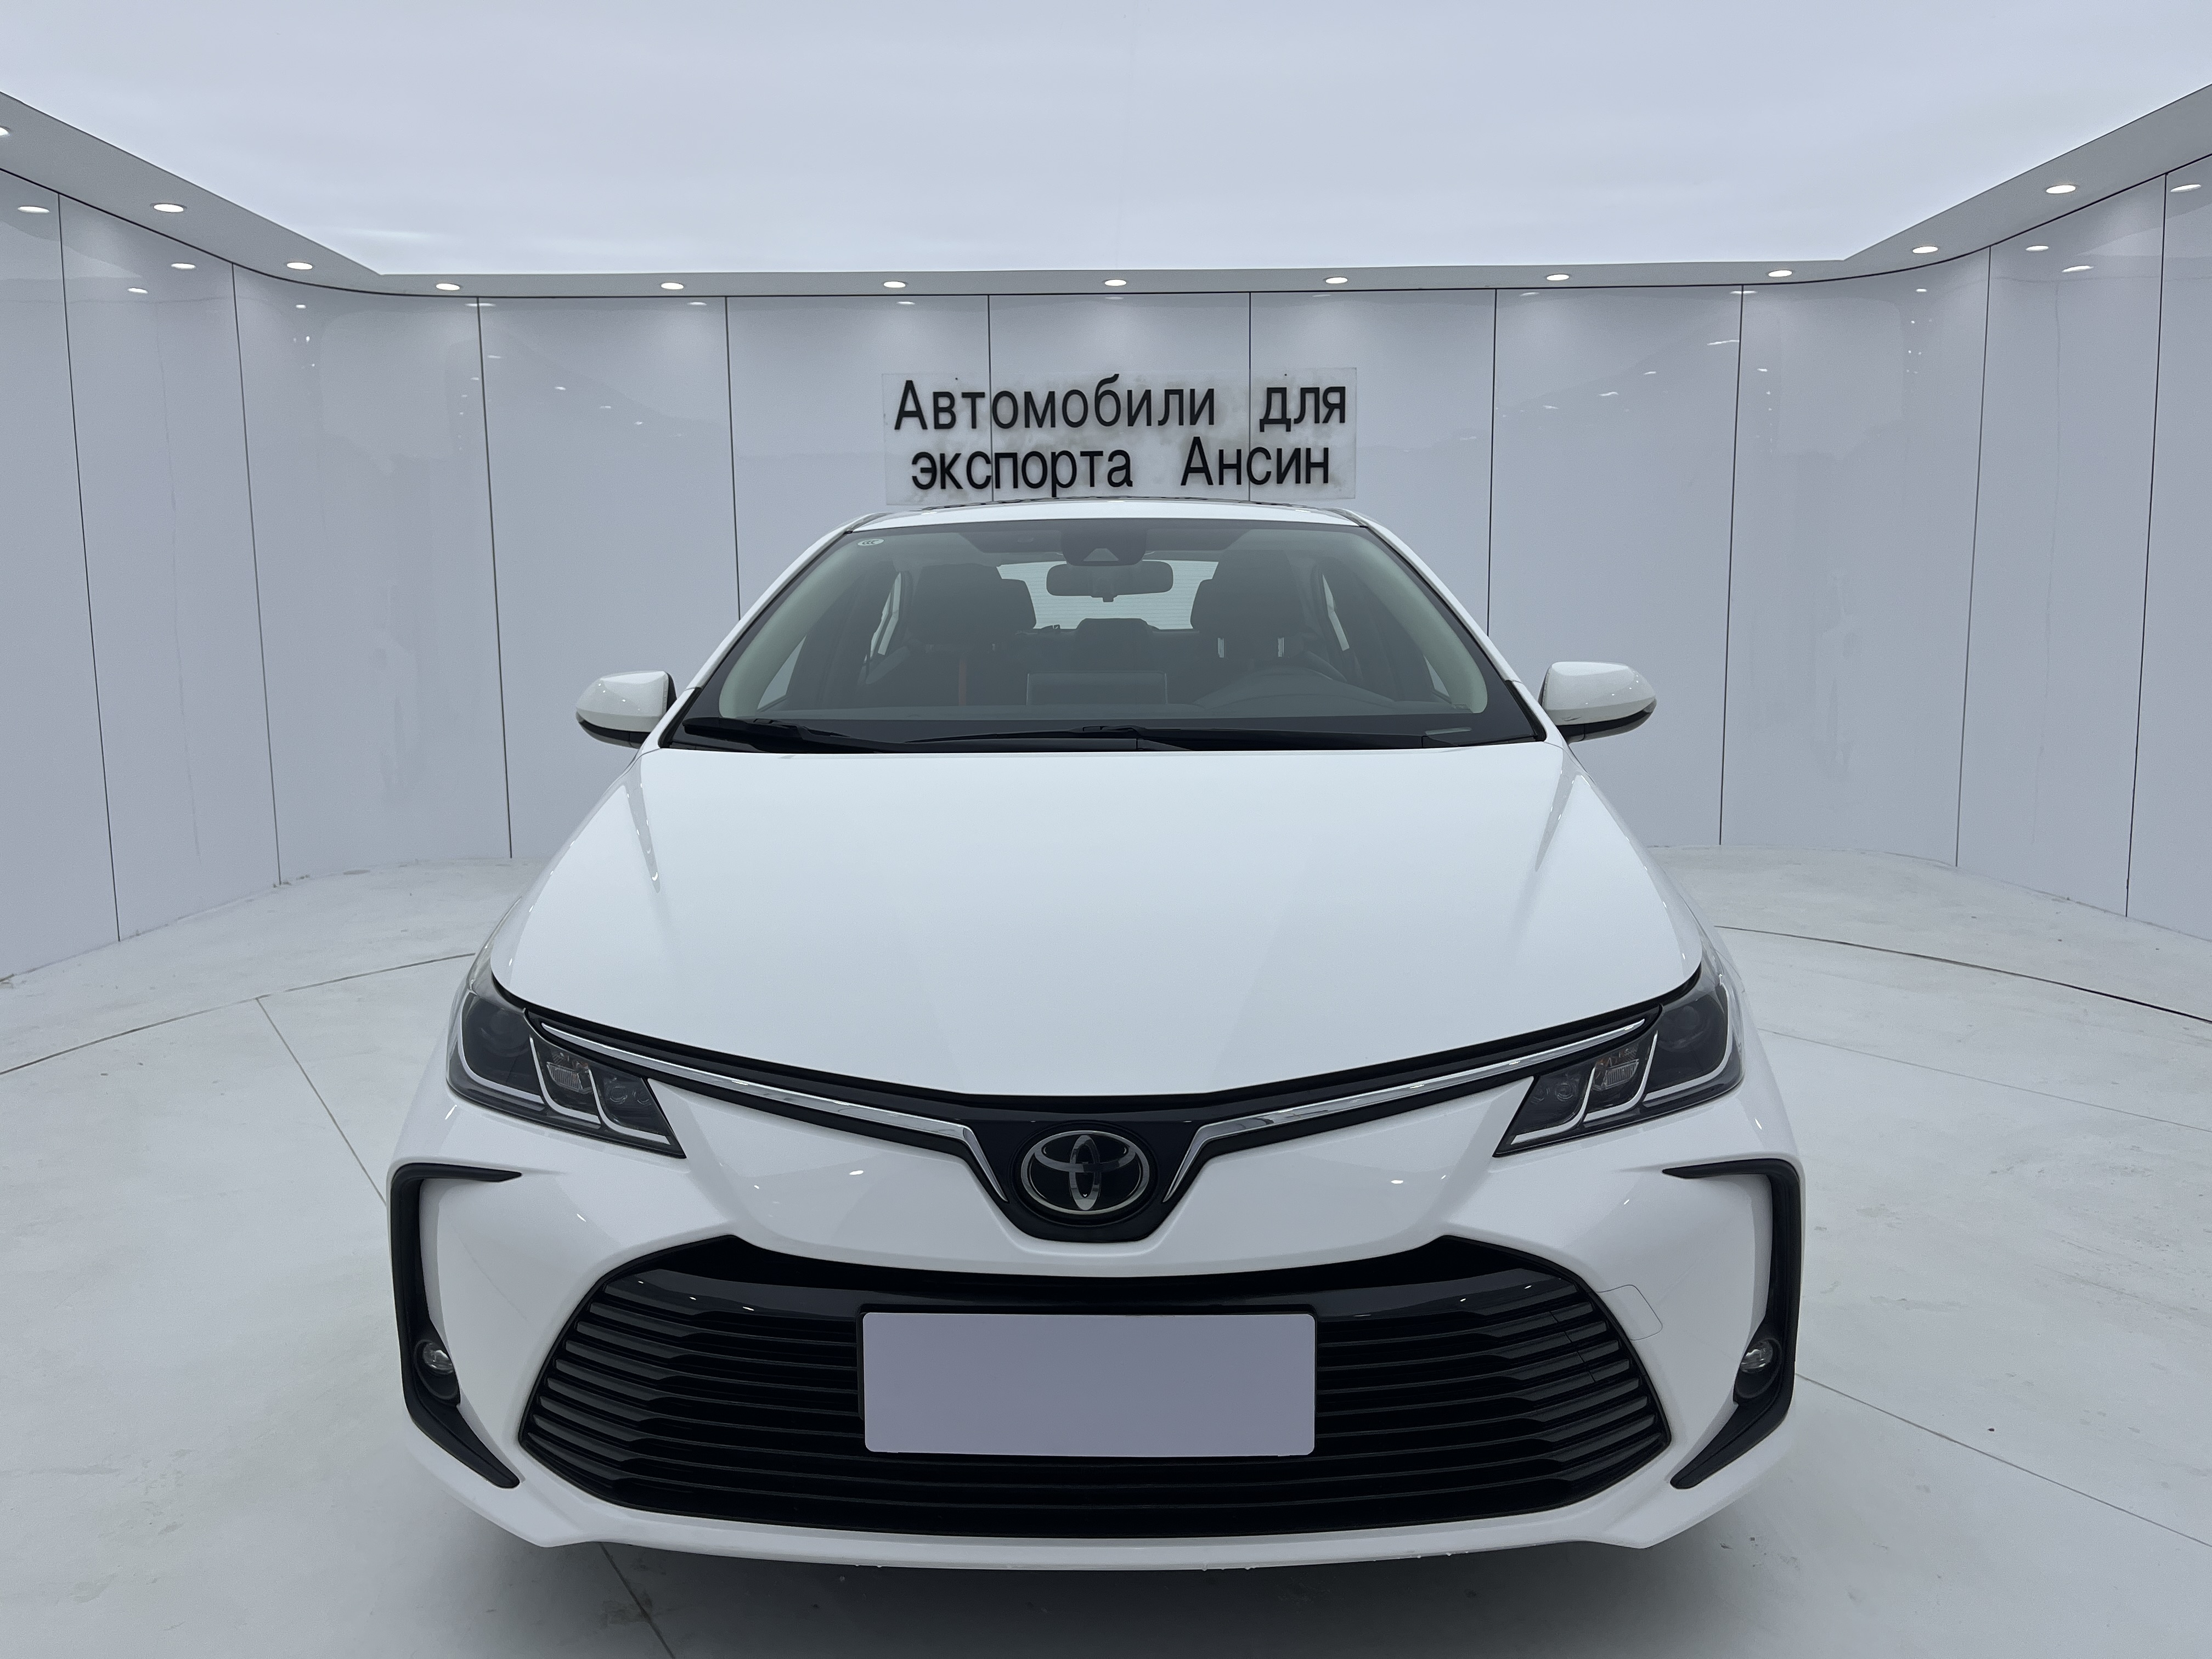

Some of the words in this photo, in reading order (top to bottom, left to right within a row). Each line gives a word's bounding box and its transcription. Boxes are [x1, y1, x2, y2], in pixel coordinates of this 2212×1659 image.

[894, 373, 1215, 430] Автомобили
[1259, 386, 1346, 432] для
[911, 449, 1133, 498] экспорта
[1180, 436, 1329, 486] Ансин
